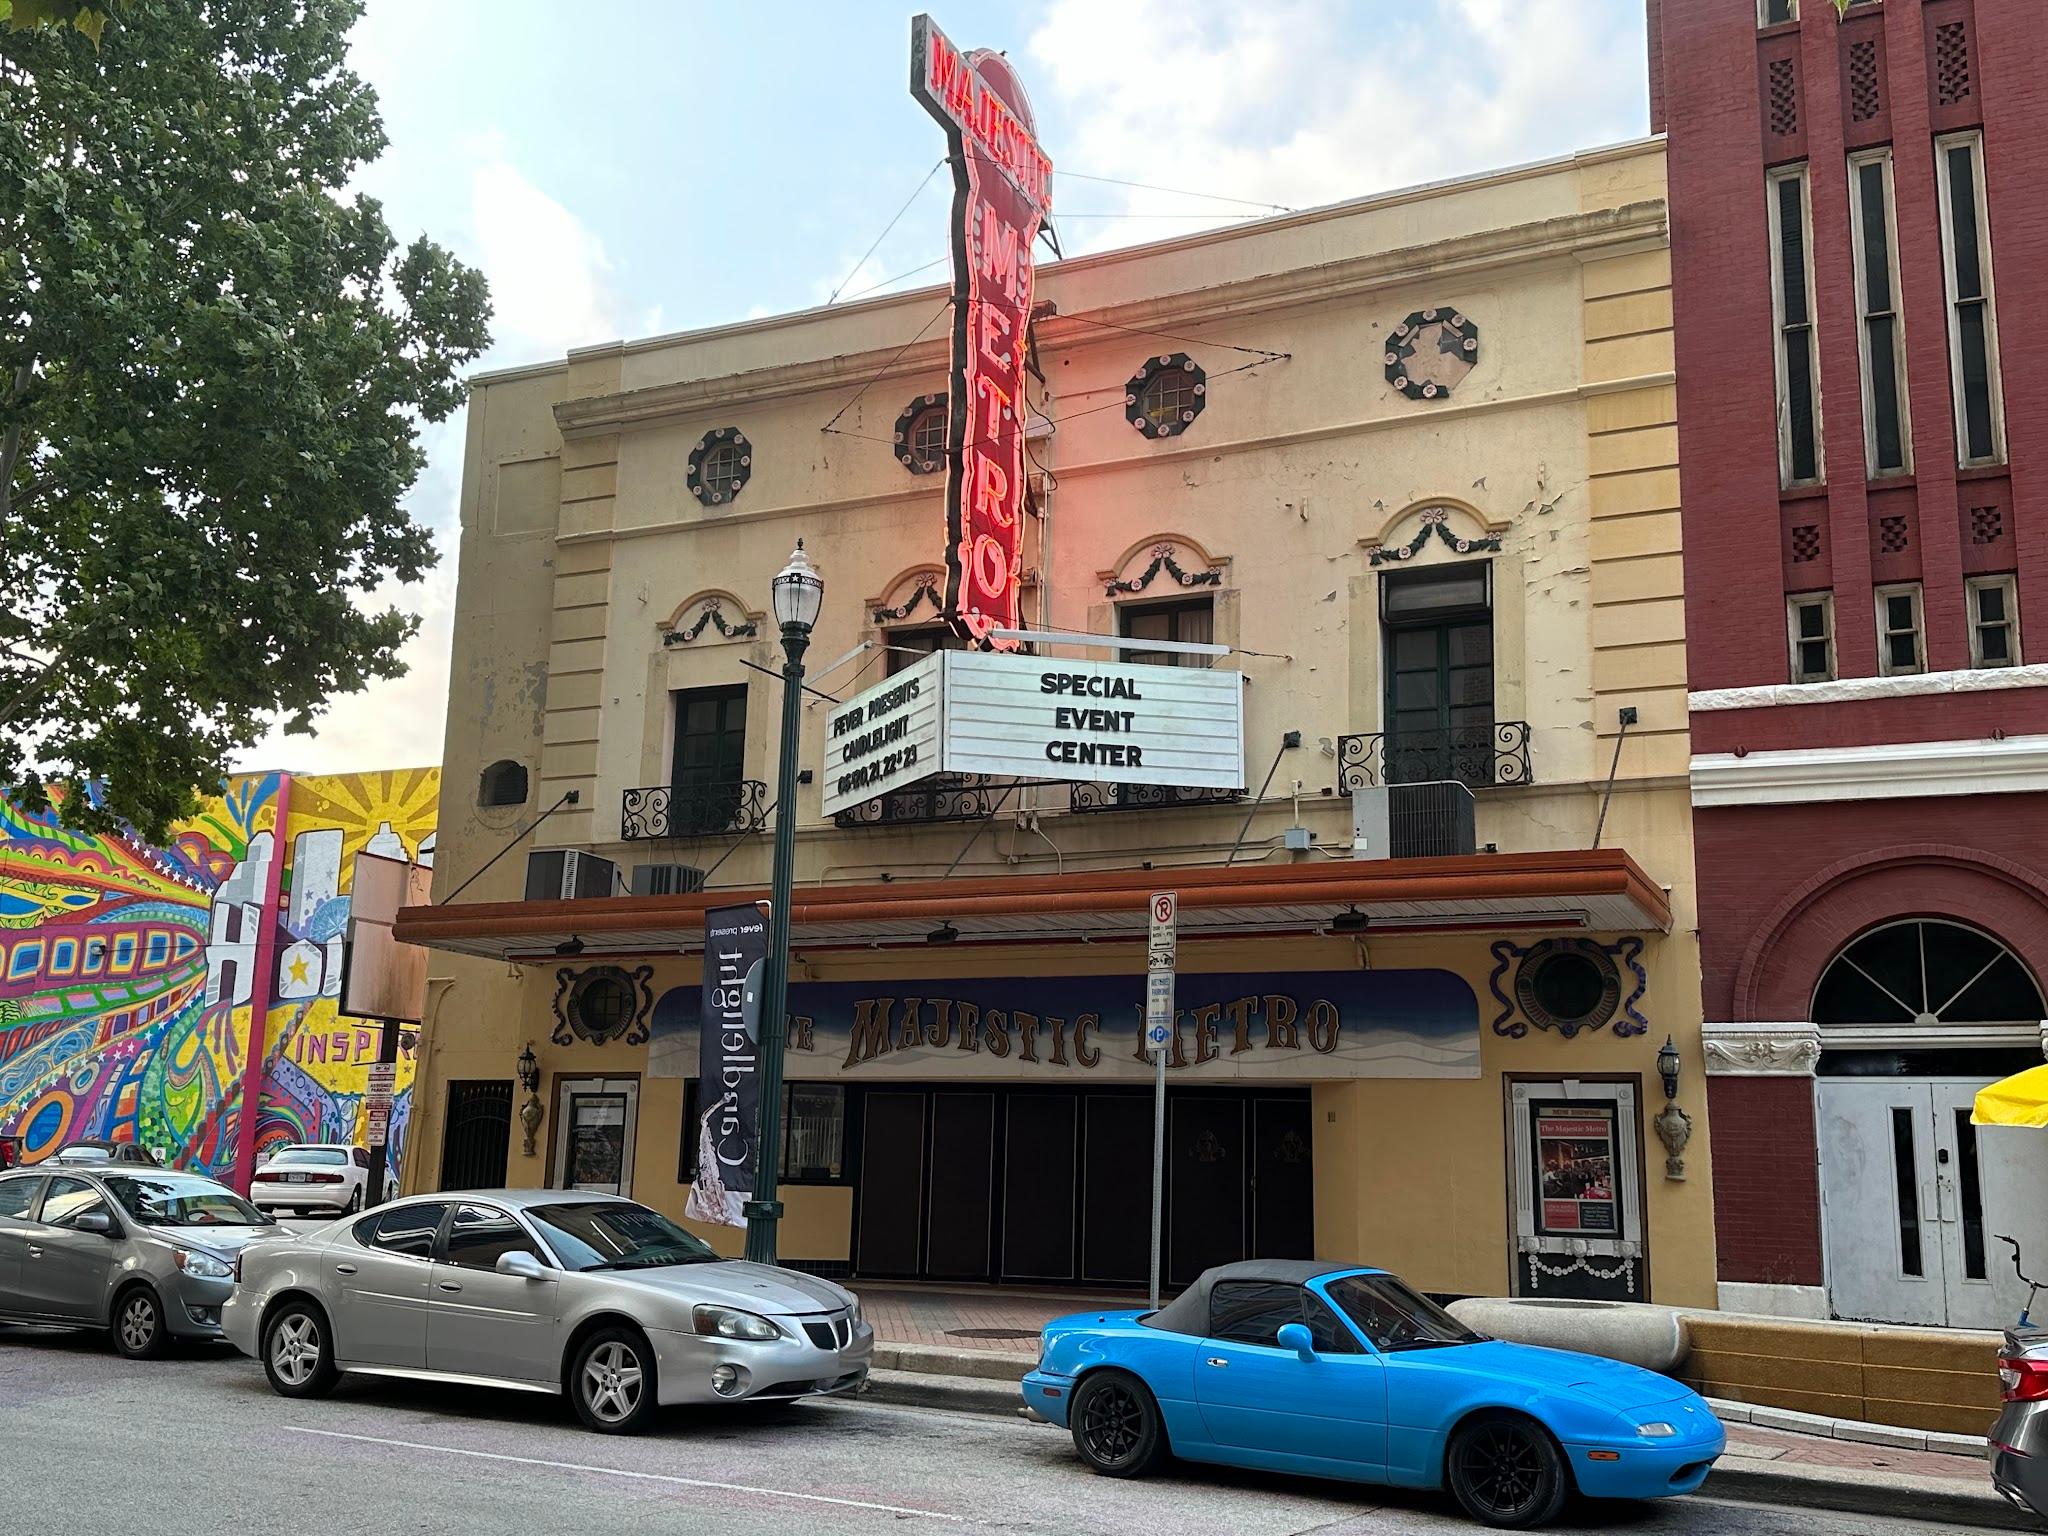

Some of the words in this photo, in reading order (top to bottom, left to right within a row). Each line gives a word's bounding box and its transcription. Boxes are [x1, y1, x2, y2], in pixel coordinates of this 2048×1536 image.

[930, 30, 1053, 210] MAJESTIC
[974, 198, 1018, 599] METRO
[1040, 672, 1142, 701] SPECIAL
[833, 706, 863, 739] FEVER
[868, 677, 920, 721] PRESENTS
[1055, 706, 1135, 733] EVENT
[842, 714, 909, 764] CANDLELIGHT
[903, 744, 917, 768] 23
[1045, 740, 1142, 767] CENTER
[295, 1030, 419, 1064] INSPI
[842, 998, 1099, 1070] MAJESTIC
[1555, 1125, 1584, 1133] Majestic
